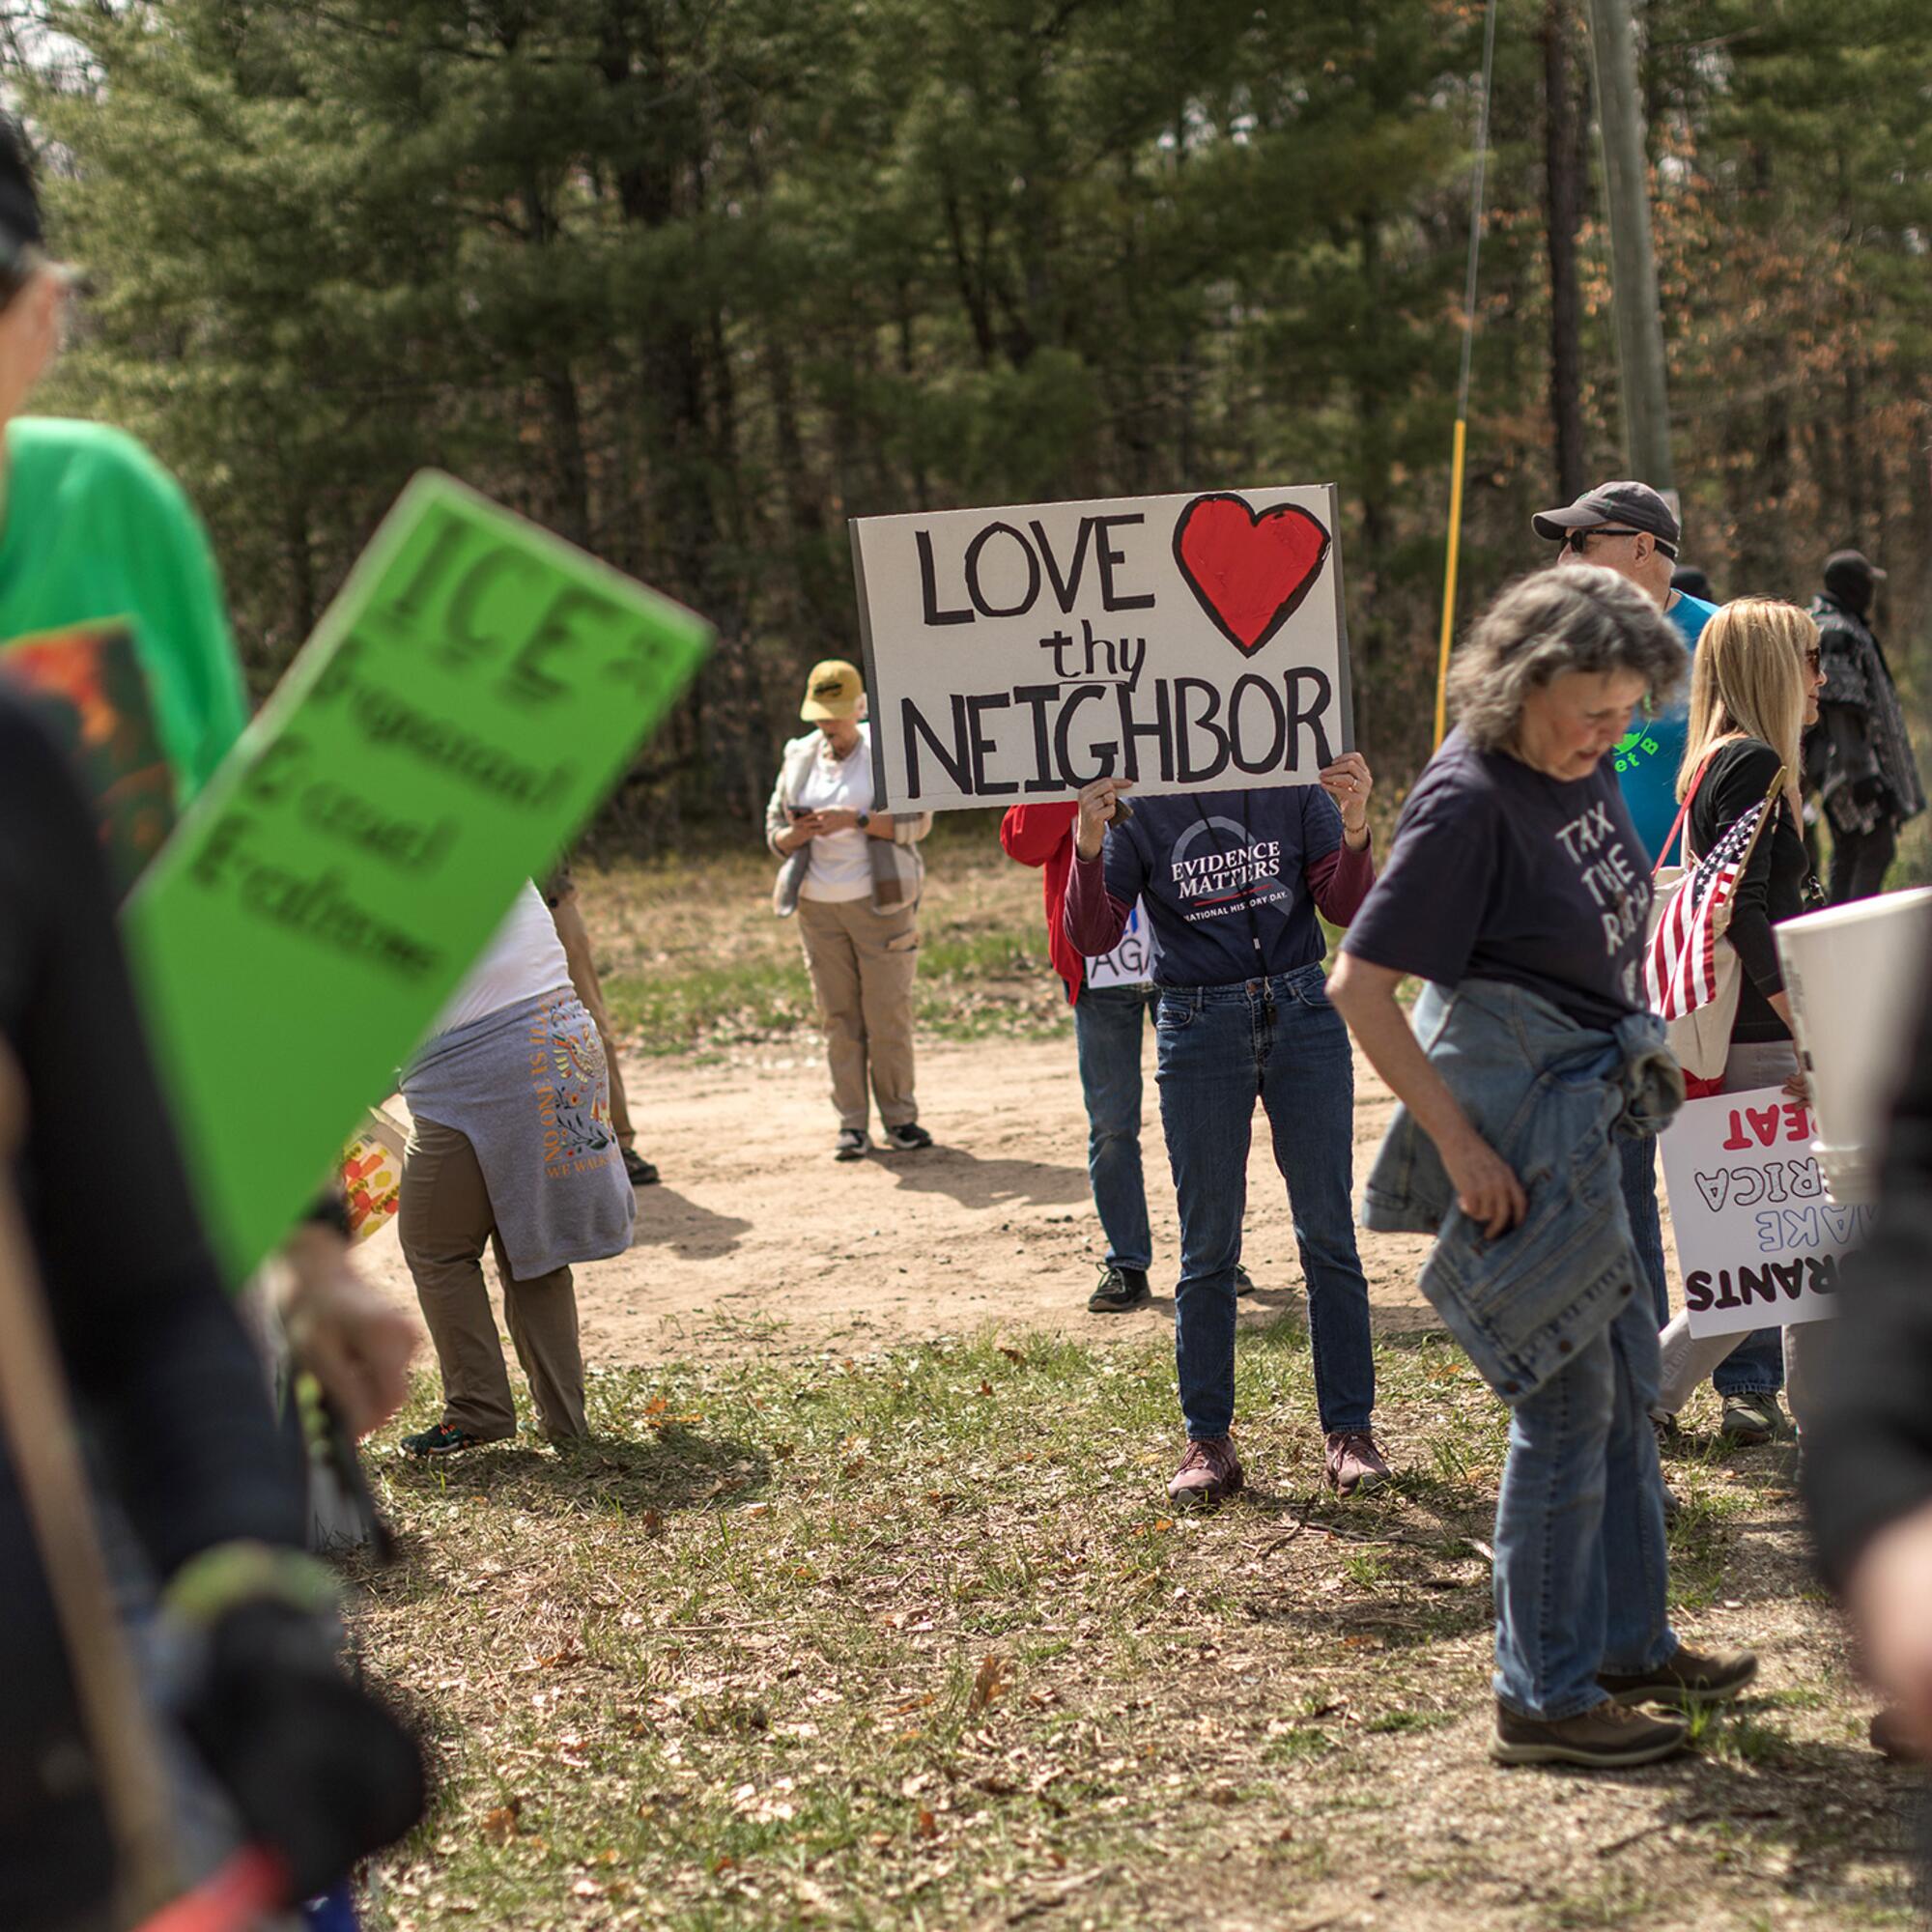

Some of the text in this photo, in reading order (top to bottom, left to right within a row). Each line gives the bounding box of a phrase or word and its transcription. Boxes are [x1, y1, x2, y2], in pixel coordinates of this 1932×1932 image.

[915, 513, 1155, 626] LOVE
[1039, 619, 1146, 693] thy
[901, 667, 1333, 799] NEIGHBOR
[1554, 801, 1615, 864] TAX
[1171, 840, 1281, 882] EVIDENCE
[1179, 858, 1280, 899] MATTERS
[1580, 842, 1635, 907] THE
[1231, 896, 1267, 913] HISORY
[1091, 937, 1151, 980] AG
[530, 1050, 549, 1075] IS
[542, 1130, 562, 1161] NO
[1722, 1102, 1817, 1151] EAT
[1694, 1156, 1824, 1212] RICA
[1687, 1254, 1837, 1311] RANTS
